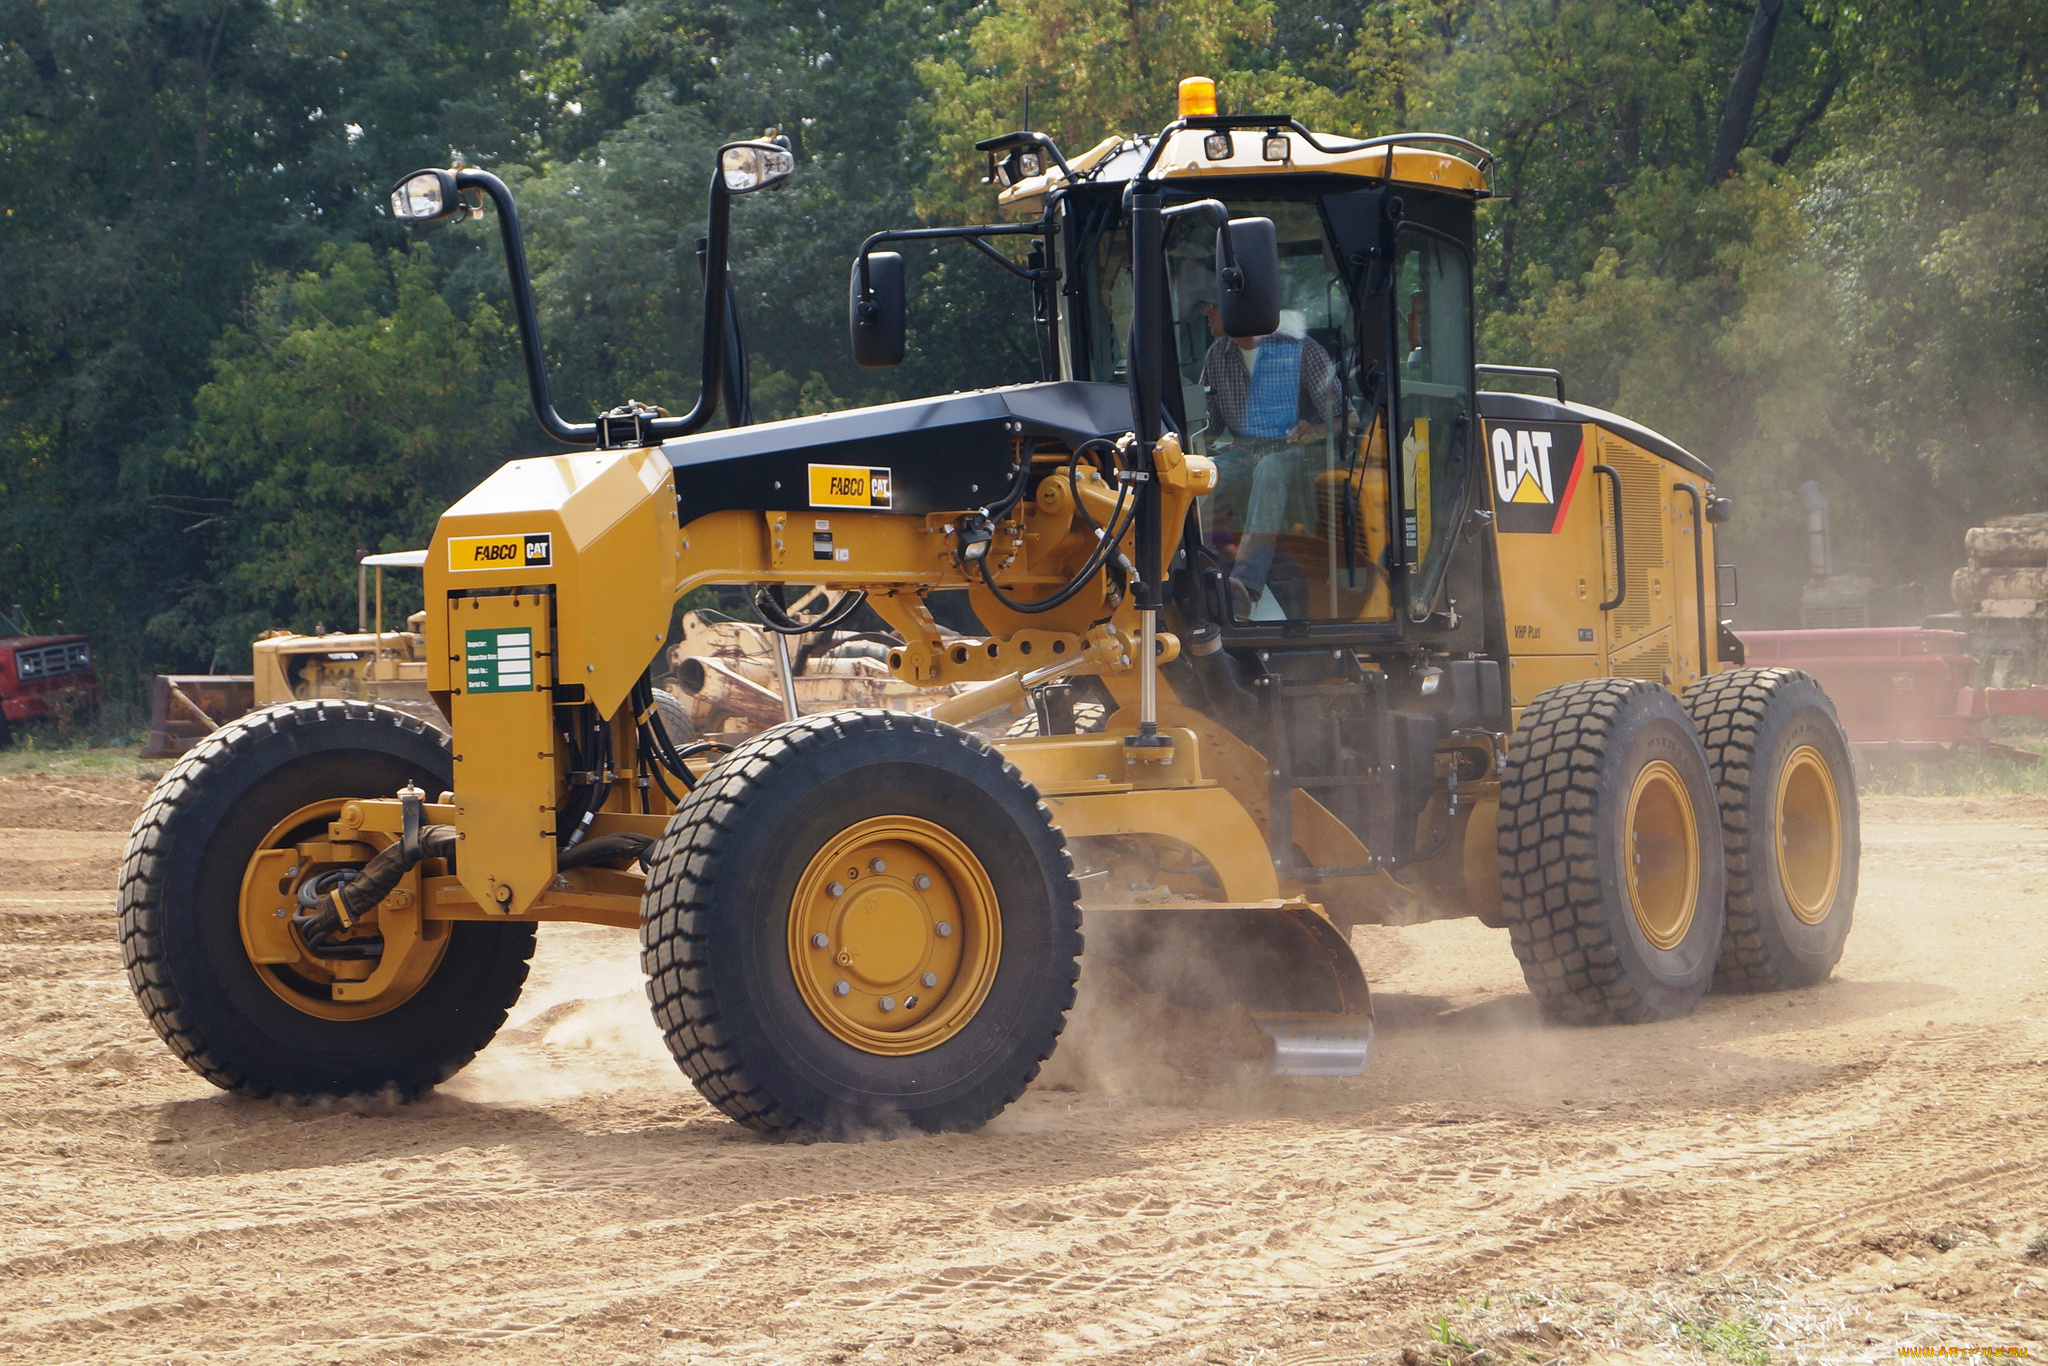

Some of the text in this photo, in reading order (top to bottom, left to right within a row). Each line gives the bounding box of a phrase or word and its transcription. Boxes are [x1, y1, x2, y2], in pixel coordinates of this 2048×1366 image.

[1492, 427, 1554, 504] CAT
[830, 476, 889, 498] FABCO CAT
[474, 542, 548, 561] FABCO CAT
[1514, 624, 1528, 639] VHP
